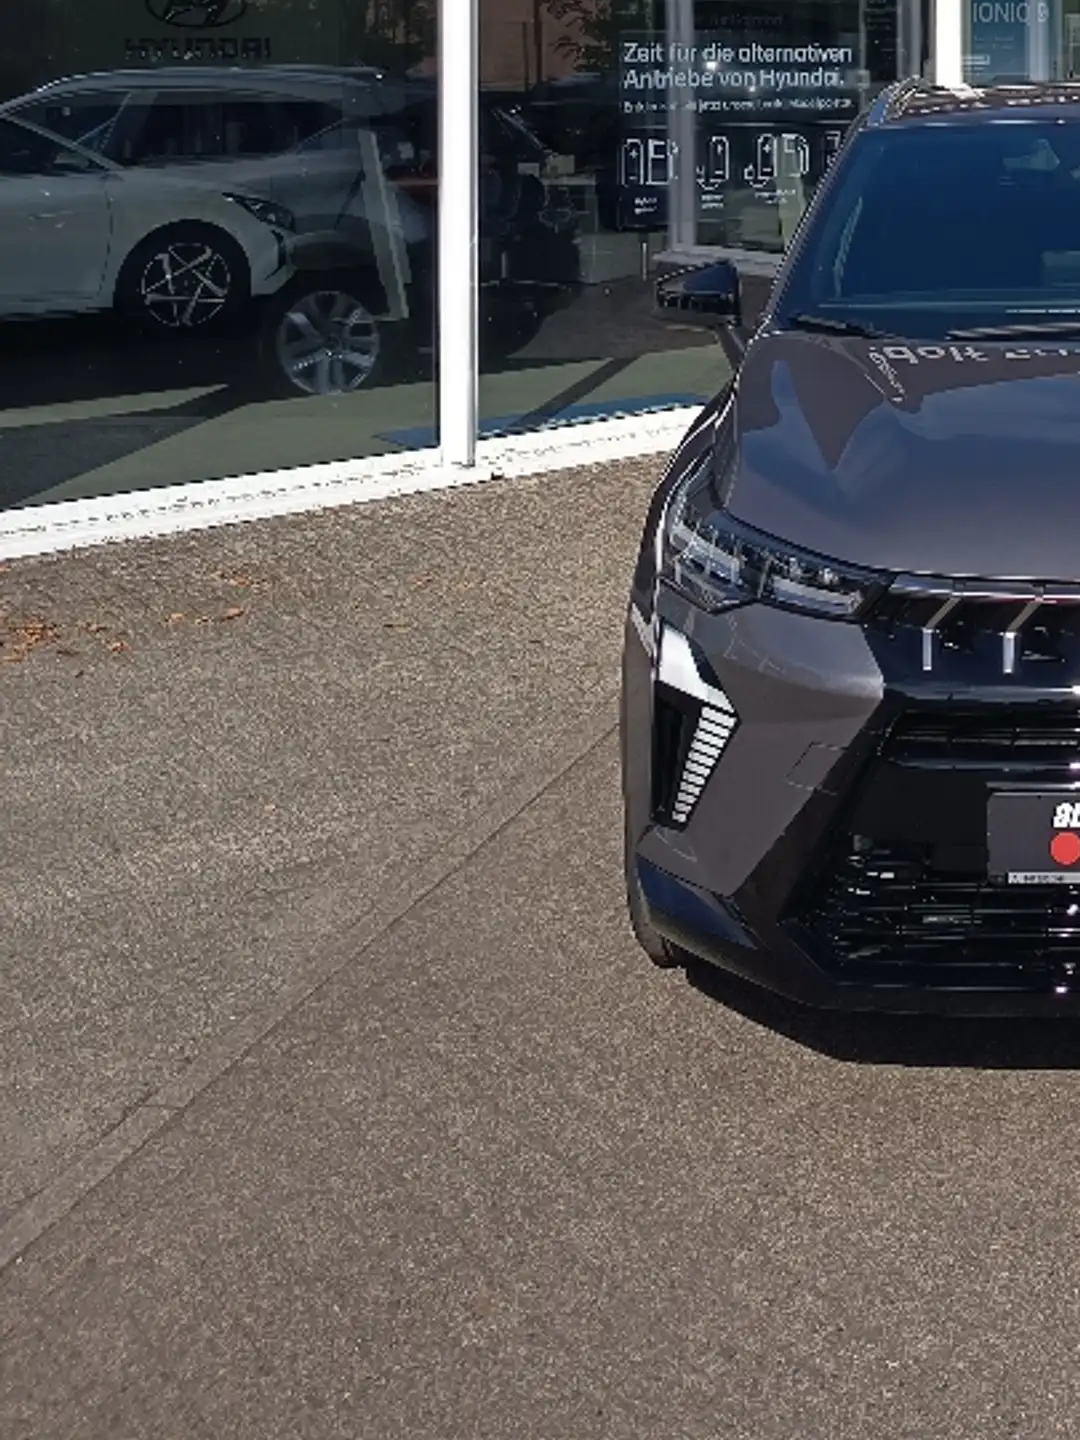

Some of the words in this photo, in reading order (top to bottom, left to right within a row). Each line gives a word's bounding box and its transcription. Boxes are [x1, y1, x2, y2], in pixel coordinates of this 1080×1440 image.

[623, 43, 663, 63] Zeit
[668, 43, 697, 63] für
[702, 42, 734, 63] die
[738, 42, 852, 63] alternativen
[623, 68, 713, 90] Antriebe
[717, 71, 755, 87] von
